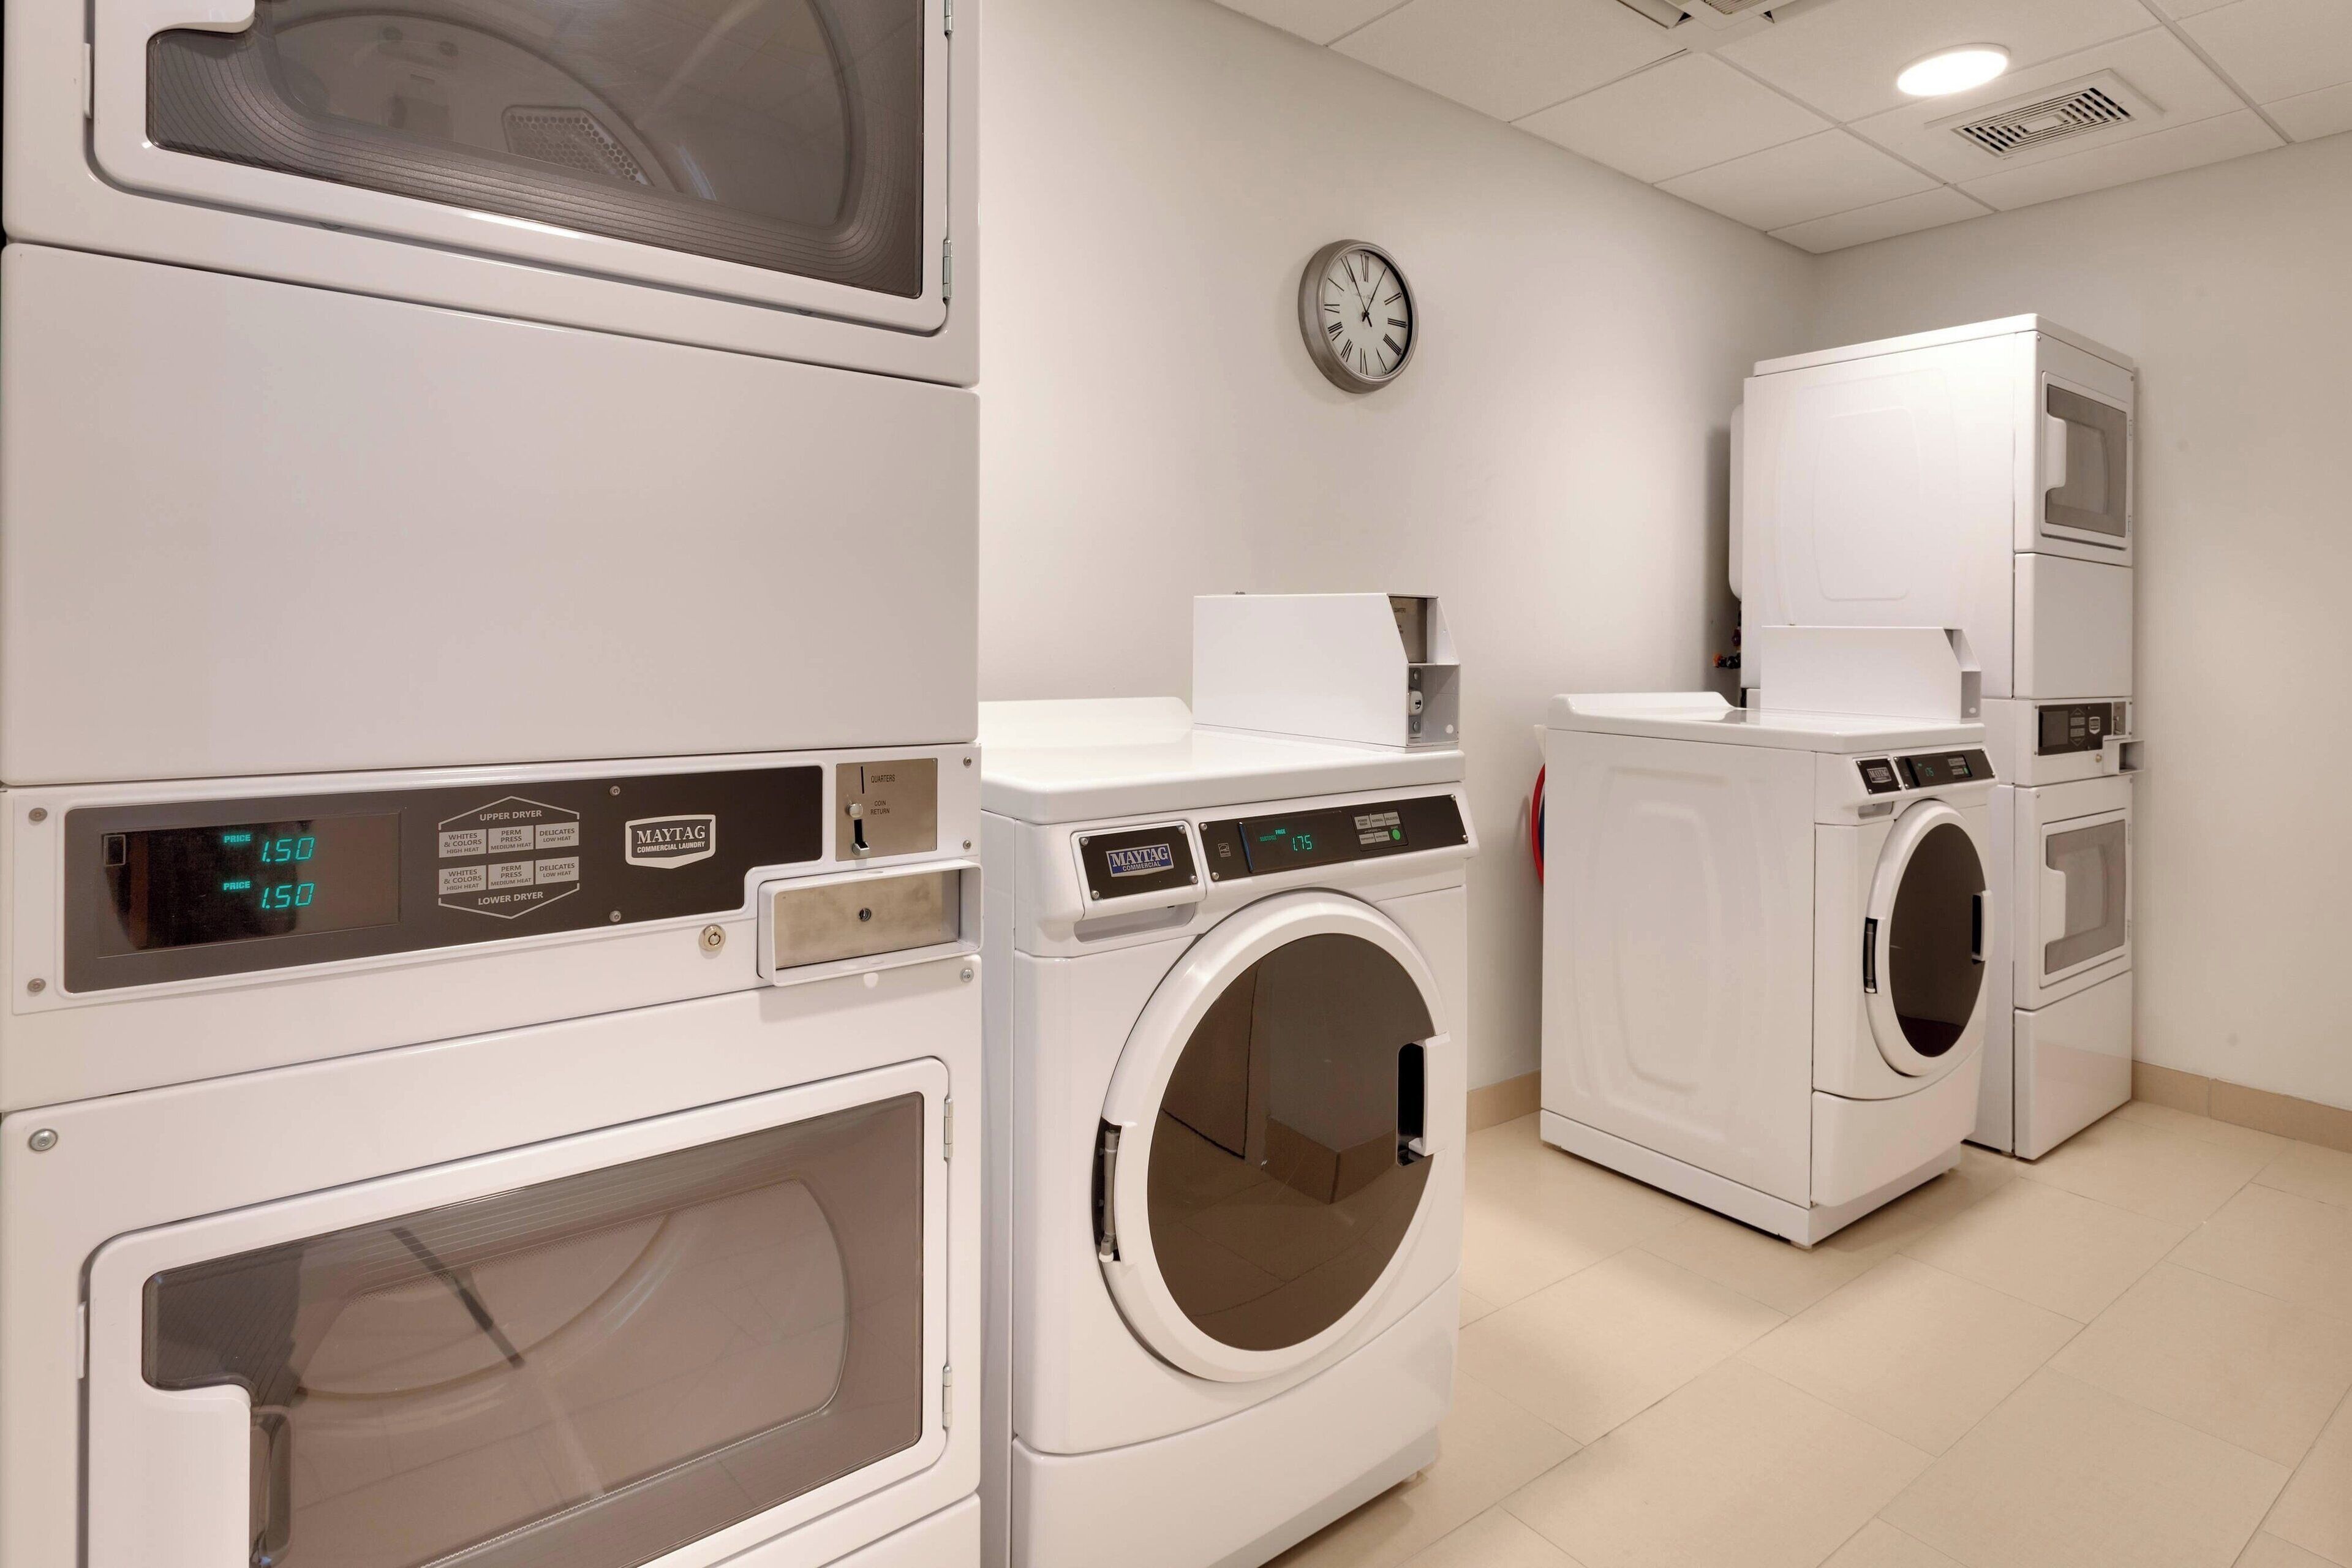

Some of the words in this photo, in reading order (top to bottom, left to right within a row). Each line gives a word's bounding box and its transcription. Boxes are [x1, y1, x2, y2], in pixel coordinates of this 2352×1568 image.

[871, 774, 895, 783] QUARTERS
[480, 812, 510, 821] UPPER
[513, 810, 542, 819] DRYER
[637, 826, 705, 844] MAYTAG
[224, 834, 251, 843] PRICE
[262, 837, 315, 862] 1.50
[637, 844, 677, 853] COMMERCIAL
[679, 841, 705, 850] LAUNDRY
[1292, 835, 1313, 851] 1.75
[1110, 847, 1168, 867] MAYTAG
[1122, 861, 1161, 871] COMMERCIAL
[224, 881, 251, 891] PRICE
[262, 883, 315, 908] 1.50
[478, 895, 511, 905] LOWER
[514, 891, 543, 902] DRYER
